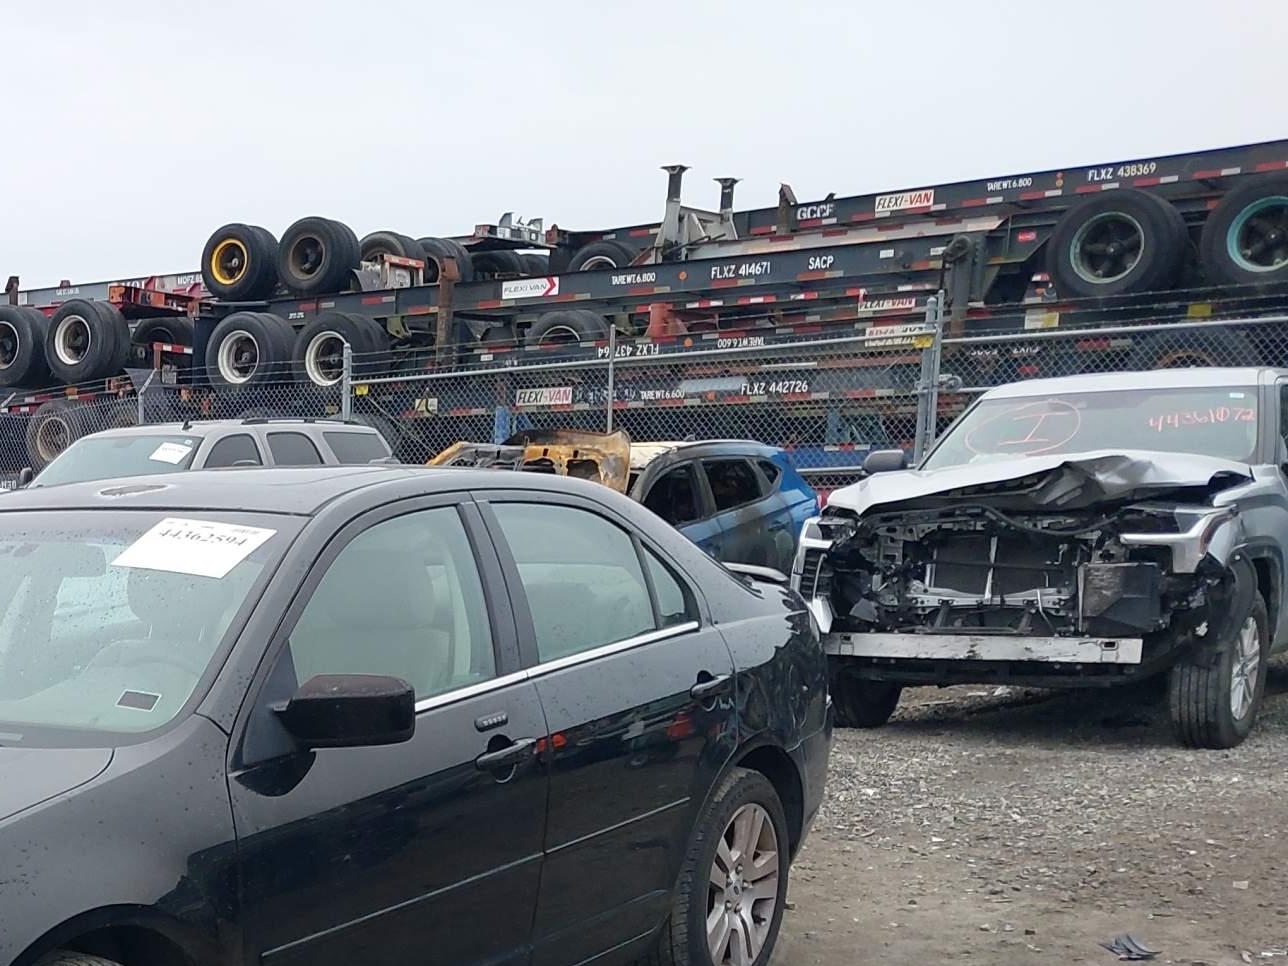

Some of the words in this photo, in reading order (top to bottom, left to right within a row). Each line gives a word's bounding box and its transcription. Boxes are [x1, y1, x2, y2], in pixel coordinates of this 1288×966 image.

[1087, 168, 1113, 181] FLXZ
[1117, 162, 1156, 178] 438369
[808, 255, 834, 270] SACP
[711, 265, 736, 279] FLXZ
[738, 262, 771, 276] 414671
[598, 346, 631, 358] 43764
[636, 343, 659, 356] FLXZ
[741, 382, 765, 396] FLXZ
[768, 381, 808, 394] 442726
